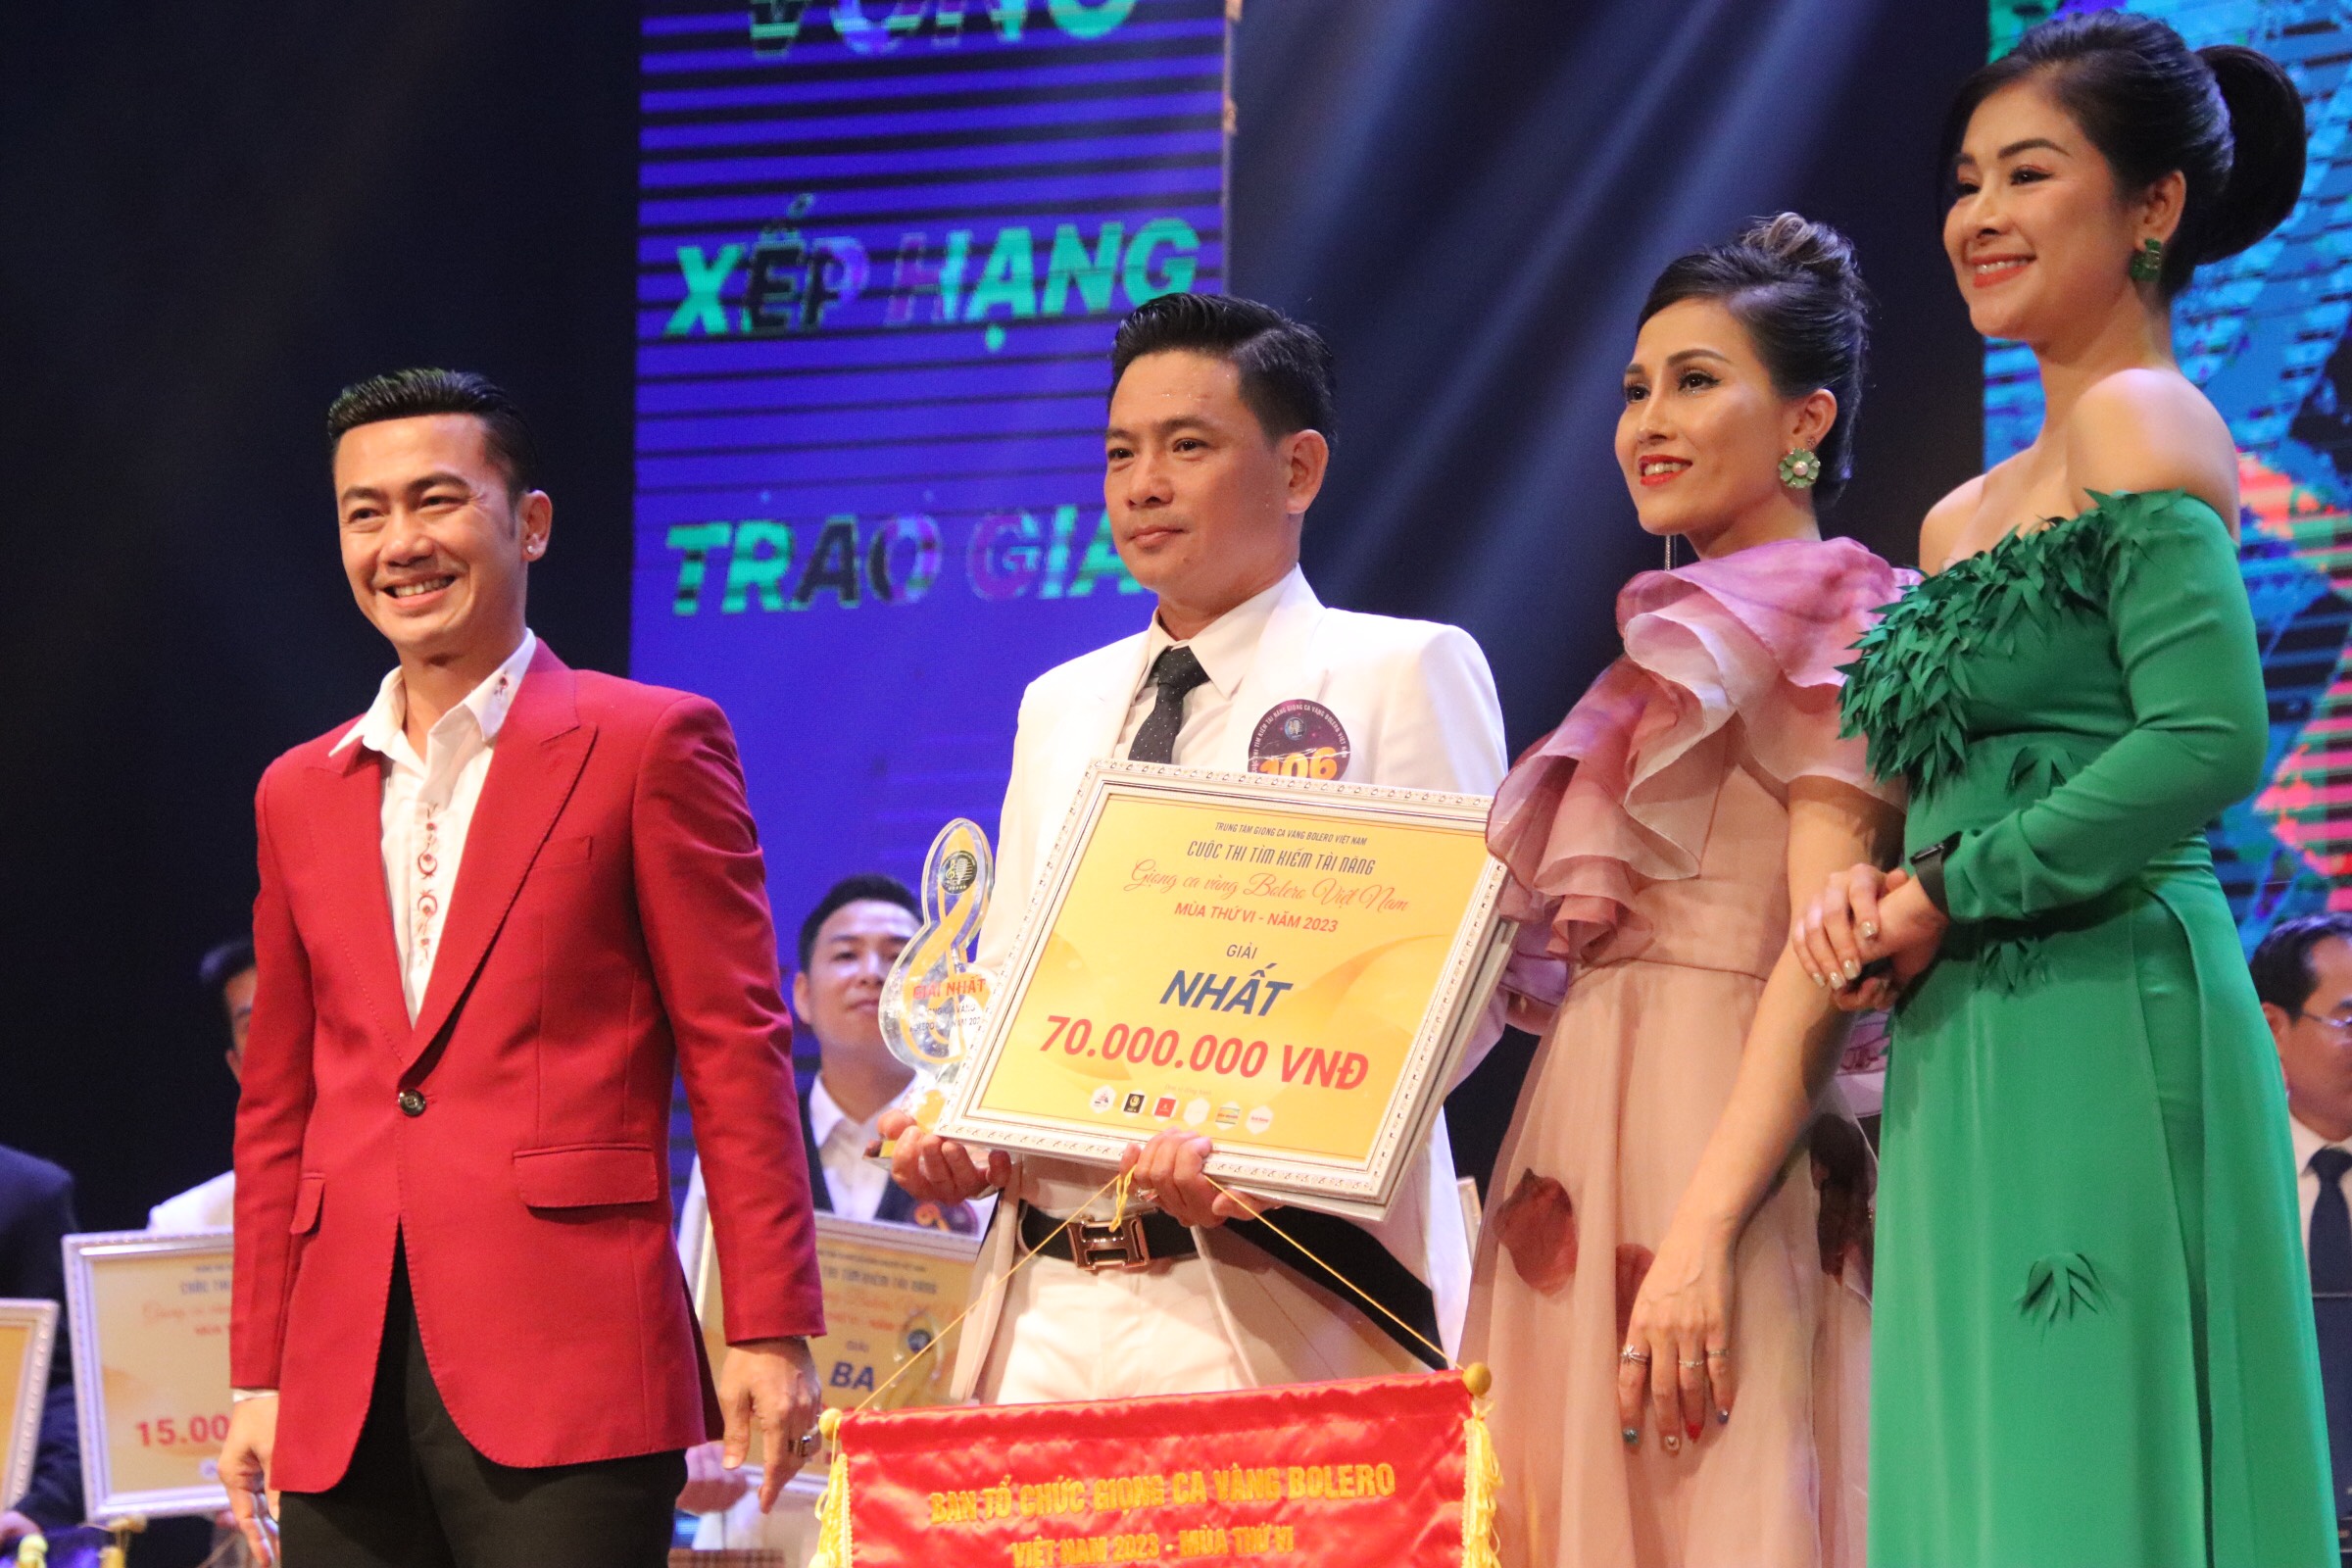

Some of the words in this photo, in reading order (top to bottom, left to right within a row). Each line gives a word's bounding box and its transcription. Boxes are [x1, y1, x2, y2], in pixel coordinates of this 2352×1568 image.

[662, 193, 870, 338] XẾP
[885, 218, 1200, 351] HẠNG
[665, 514, 942, 616] TRAO
[1259, 746, 1338, 780] 106
[1214, 822, 1238, 832] TRUNG
[1253, 826, 1276, 837] GIỌNG
[1306, 831, 1334, 843] BOLERO
[1335, 834, 1350, 845] VIỆT
[1351, 836, 1368, 846] NAM
[1187, 839, 1223, 860] CUỘC
[1225, 844, 1248, 861] THI
[1250, 844, 1275, 864] TÌM
[1276, 847, 1313, 869] KIẾM
[1315, 851, 1339, 871] TÀI
[1339, 855, 1376, 875] NĂNG
[1123, 858, 1177, 894] Giọng
[1182, 876, 1200, 889] ca
[1203, 873, 1238, 900] vàng
[1243, 872, 1306, 900] Bolero
[1311, 877, 1359, 908] Việt
[1358, 884, 1409, 913] Nam
[1175, 901, 1206, 918] MÙA
[1210, 904, 1241, 921] THỨ
[1242, 909, 1256, 923] VI
[1267, 910, 1301, 928] NĂM
[1302, 915, 1339, 933] 2023
[1226, 942, 1257, 959] GIẢI
[1158, 962, 1295, 1017] NHẤT
[1040, 1014, 1269, 1078] 70.000.000
[1280, 1044, 1369, 1091] VNĐ
[830, 1361, 874, 1393] BA
[135, 1414, 230, 1447] 15.00
[931, 1491, 977, 1524] BAN
[1019, 1475, 1085, 1517] CHỨC
[1093, 1475, 1165, 1516] GIỌNG
[1172, 1470, 1207, 1505] CA
[1213, 1462, 1282, 1502] VÀNG
[1287, 1462, 1396, 1500] BOLERO
[1059, 1537, 1107, 1566] NAM
[1112, 1533, 1159, 1561] 2023
[1178, 1523, 1229, 1558] MÙA
[1231, 1520, 1272, 1555] THỨ
[1274, 1526, 1294, 1554] VI
